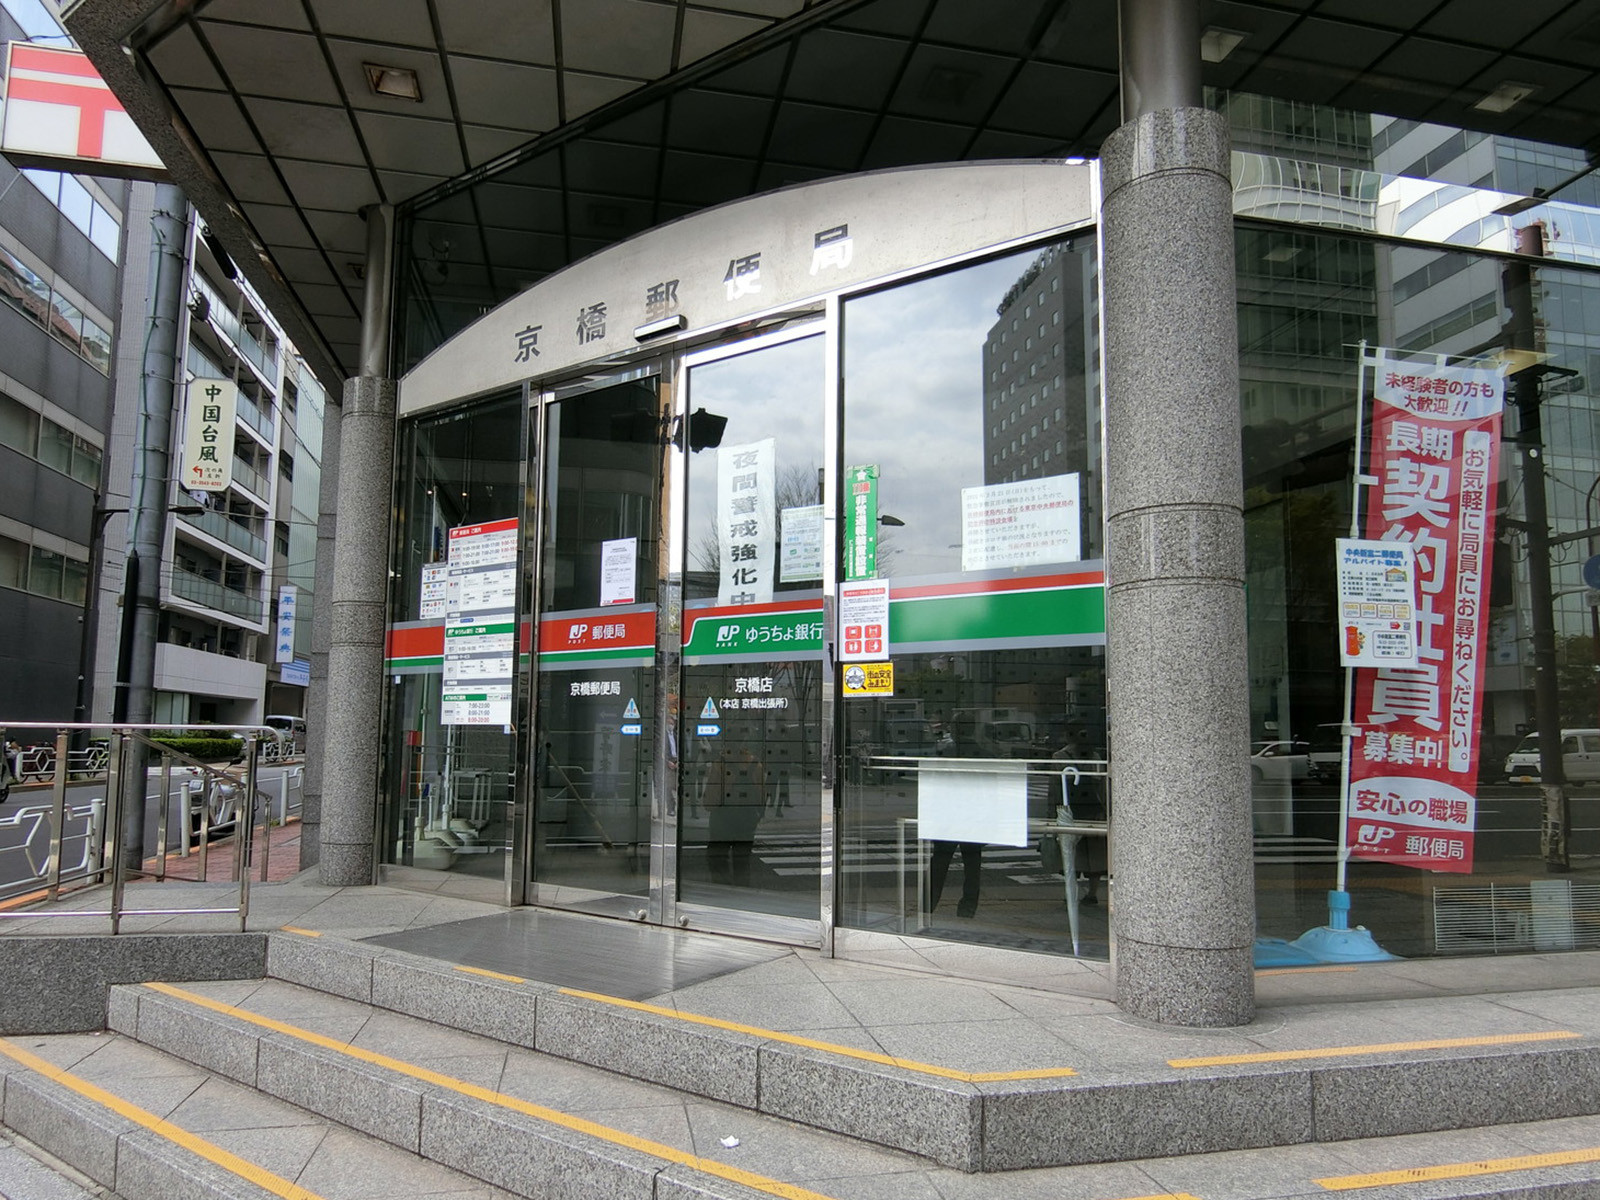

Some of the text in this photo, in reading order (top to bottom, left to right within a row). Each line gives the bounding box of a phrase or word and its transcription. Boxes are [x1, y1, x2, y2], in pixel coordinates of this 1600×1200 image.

[514, 224, 854, 364] 京橋郵便局
[1385, 371, 1495, 399] 未経験者の方も
[198, 384, 222, 463] 中国台風
[1386, 420, 1454, 461] 長期
[730, 449, 758, 606] 夜間警戒強化中
[1450, 447, 1485, 762] お気軽に局員にお尋ねください。
[592, 624, 626, 640] 郵便局
[745, 622, 823, 643] ゆうちょ銀行
[570, 681, 621, 696] 京橋郵便局
[735, 676, 773, 694] 京橋店
[742, 697, 789, 709] 京橋出張所）
[1363, 730, 1443, 769] 募集中!
[1356, 789, 1468, 825] 安心の職場
[1405, 835, 1464, 860] 郵便局
